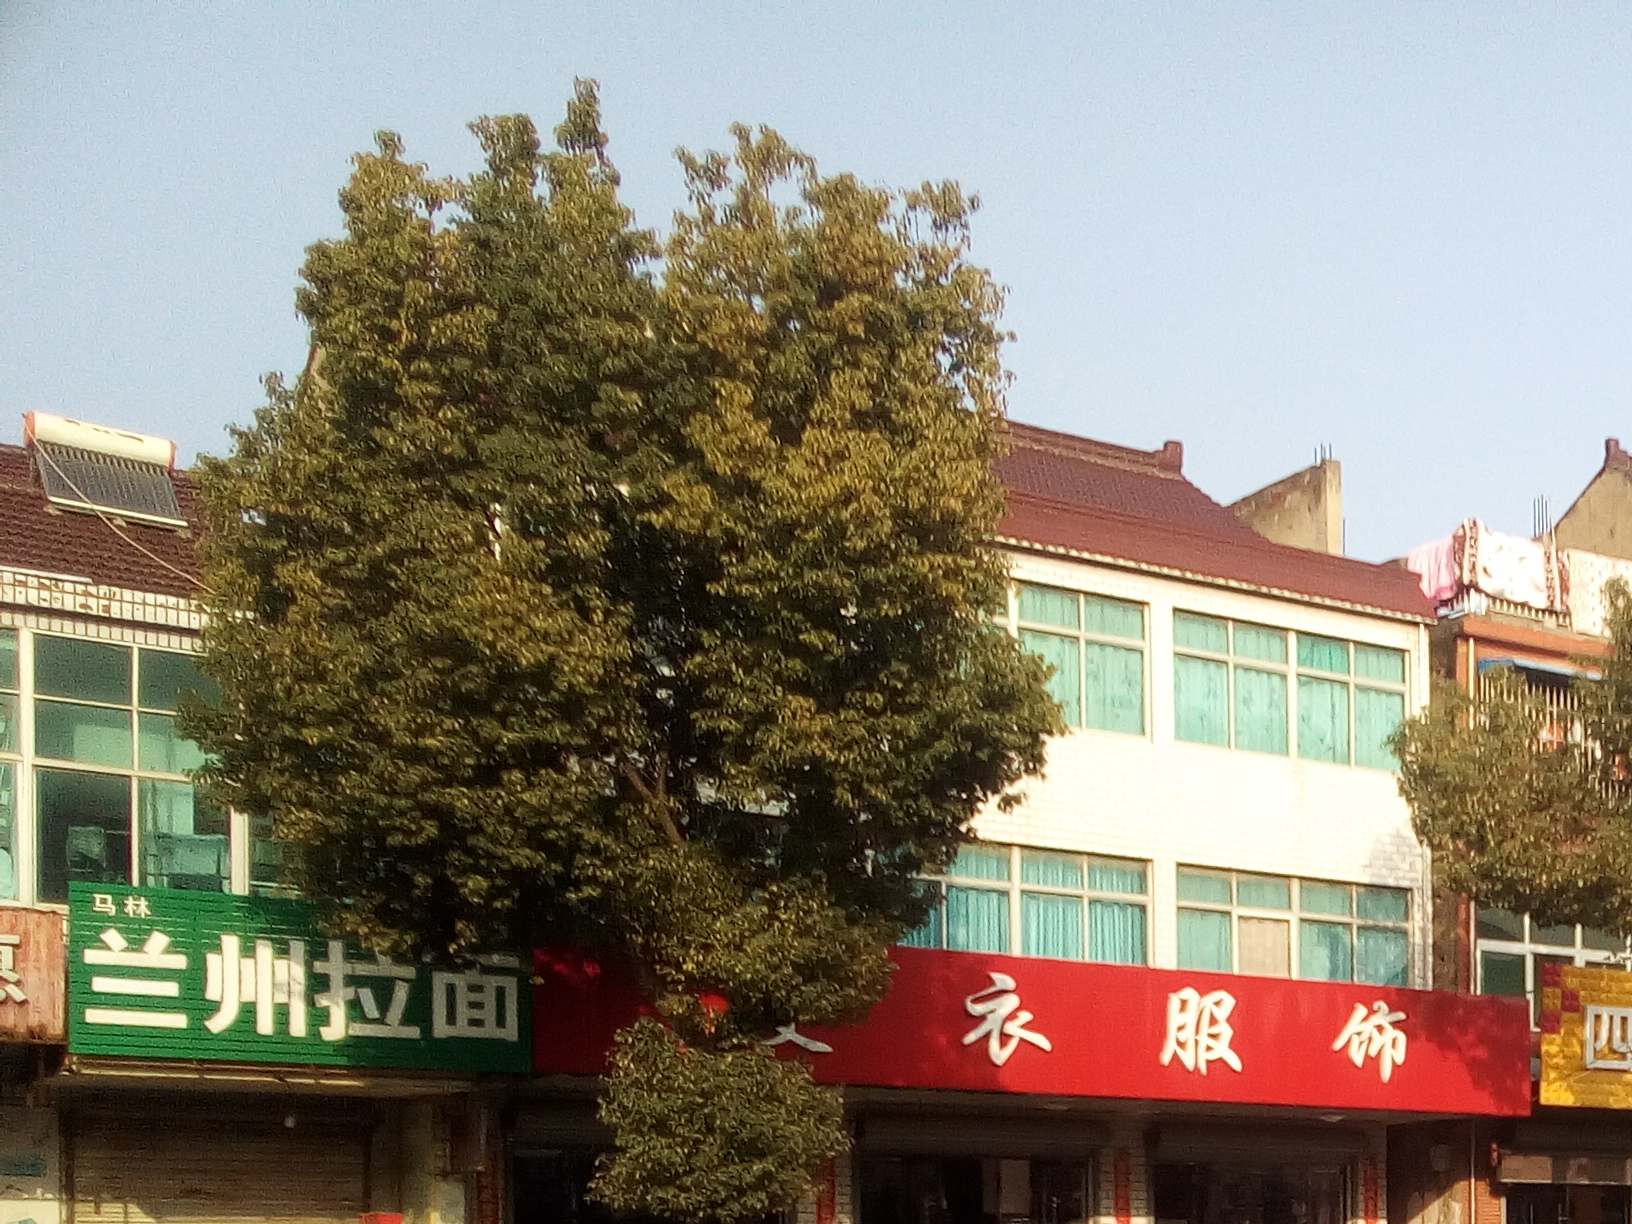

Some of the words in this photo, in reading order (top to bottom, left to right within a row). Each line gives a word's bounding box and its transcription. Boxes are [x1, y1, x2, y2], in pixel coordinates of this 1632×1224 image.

[92, 893, 151, 919] 马林
[83, 927, 519, 1042] 兰州拉面
